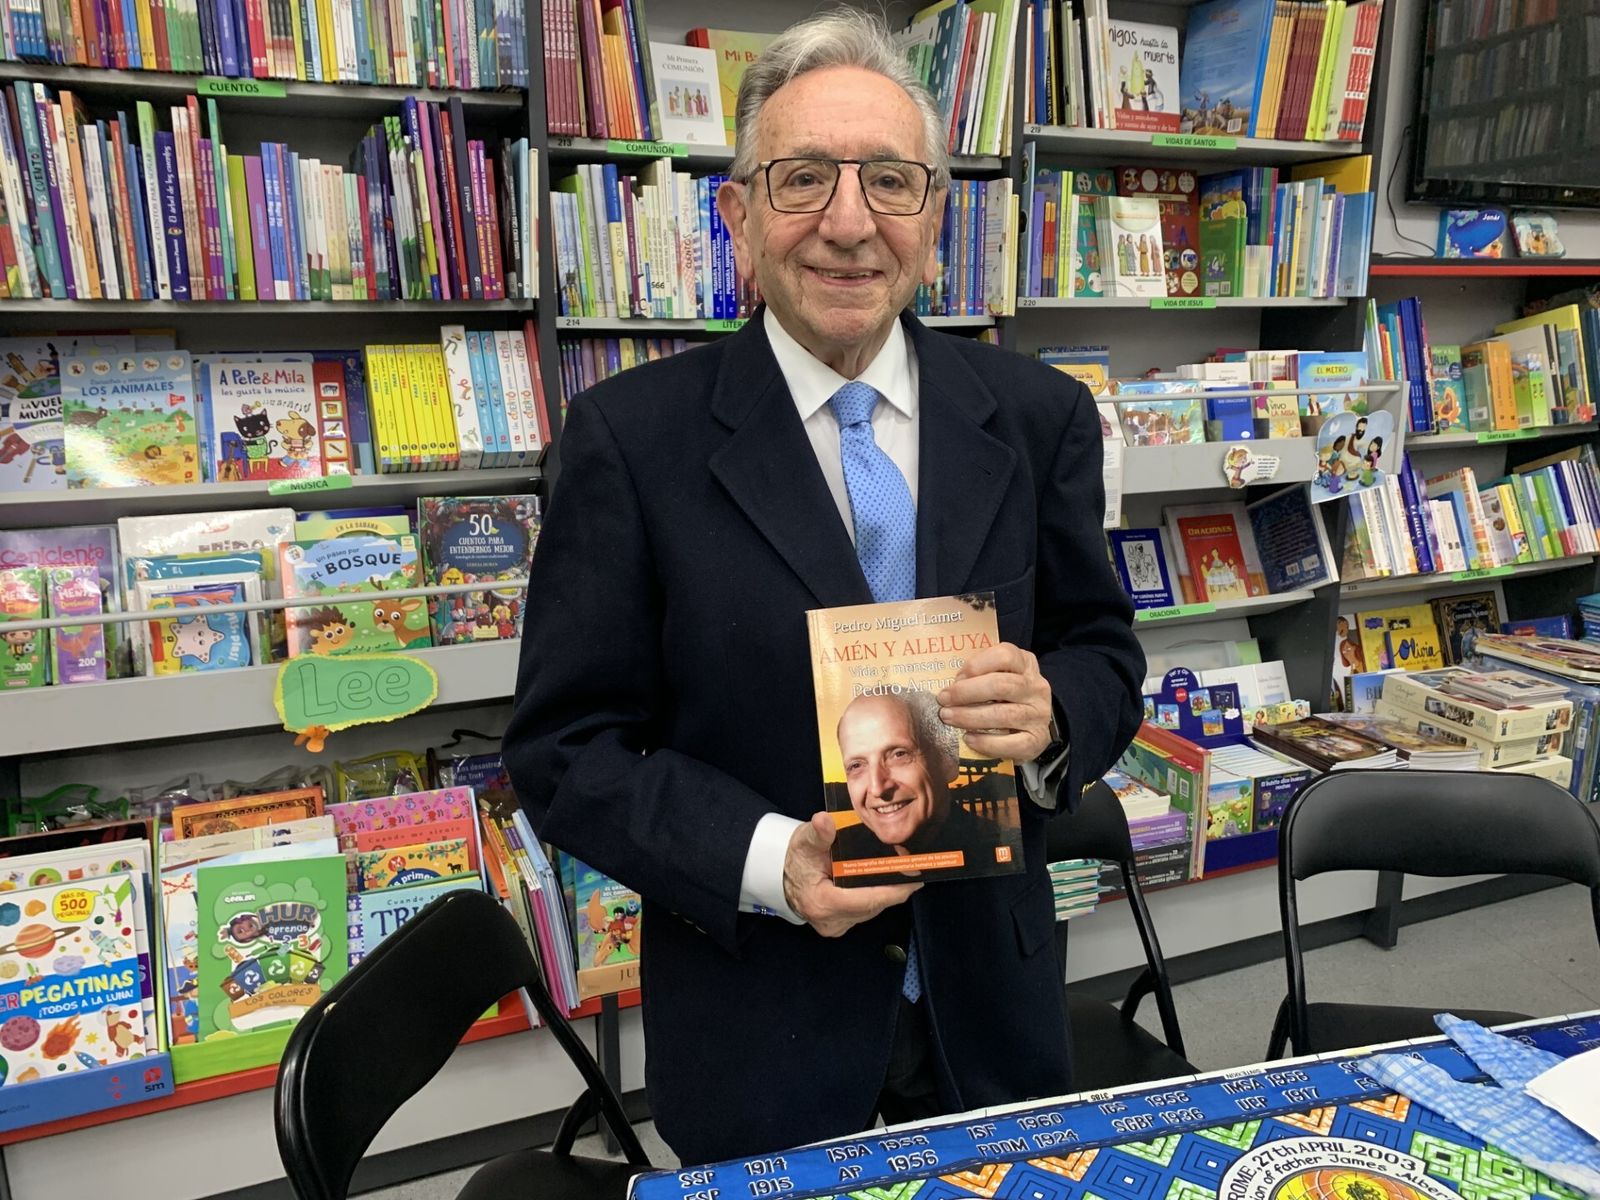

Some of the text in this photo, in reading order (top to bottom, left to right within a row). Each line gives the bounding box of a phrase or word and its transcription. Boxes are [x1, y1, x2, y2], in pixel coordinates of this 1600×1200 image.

[725, 50, 740, 61] Mi
[1144, 50, 1175, 64] muerte
[210, 82, 259, 93] CUENTOS
[558, 139, 572, 147] 213
[1165, 137, 1217, 147] VIDAS DE SANTOS
[220, 369, 228, 386] A
[275, 369, 305, 384] Mila
[81, 381, 174, 396] LOS ANIMALES
[236, 388, 261, 397] gusta
[275, 386, 305, 394] música
[469, 514, 492, 536] 50
[1188, 525, 1232, 535] ORACIONES
[458, 536, 504, 545] CUENTOS PARA
[326, 548, 360, 560] paseo por
[449, 544, 514, 554] ENTENDERNOS MEJOR
[310, 552, 401, 581] EL BOSQUE
[1149, 609, 1181, 618] ORACIONES
[834, 610, 963, 634] Pedro Miguel Lamet
[820, 632, 993, 665] AMÉN Y ALELUYA
[1398, 638, 1434, 660] Olivia
[14, 662, 32, 672] 200
[78, 657, 97, 667] 200
[849, 657, 965, 678] Vida y mensaje de
[298, 662, 411, 718] Lee
[852, 681, 902, 697] Pedro
[368, 833, 406, 844] Cuando
[59, 898, 88, 911] 500
[387, 896, 424, 905] Cuando
[258, 903, 316, 924] HUR
[298, 935, 308, 948] 3
[20, 969, 134, 1008] PEGATINAS
[268, 987, 314, 999] COLORES
[38, 989, 134, 1018] ¡TODOS A LA LUNA!
[144, 1081, 165, 1093] sm
[1221, 1078, 1264, 1096] IMSA
[1099, 1101, 1128, 1115] IGS
[1235, 1096, 1268, 1112] UCP
[966, 1112, 1066, 1140] ISF 1960
[1112, 1114, 1155, 1134] SGBP
[976, 1128, 1078, 1158] PDDM 1924
[826, 1144, 873, 1163] ISGA
[1298, 1142, 1352, 1156] APRIL
[1353, 1144, 1418, 1171] 2003
[678, 1156, 787, 1189] SSP 1914
[838, 1149, 939, 1182] AP 1956
[1264, 1170, 1276, 1184] of
[1274, 1154, 1323, 1177] father
[1330, 1153, 1388, 1170] James
[748, 1177, 794, 1196] 1915
